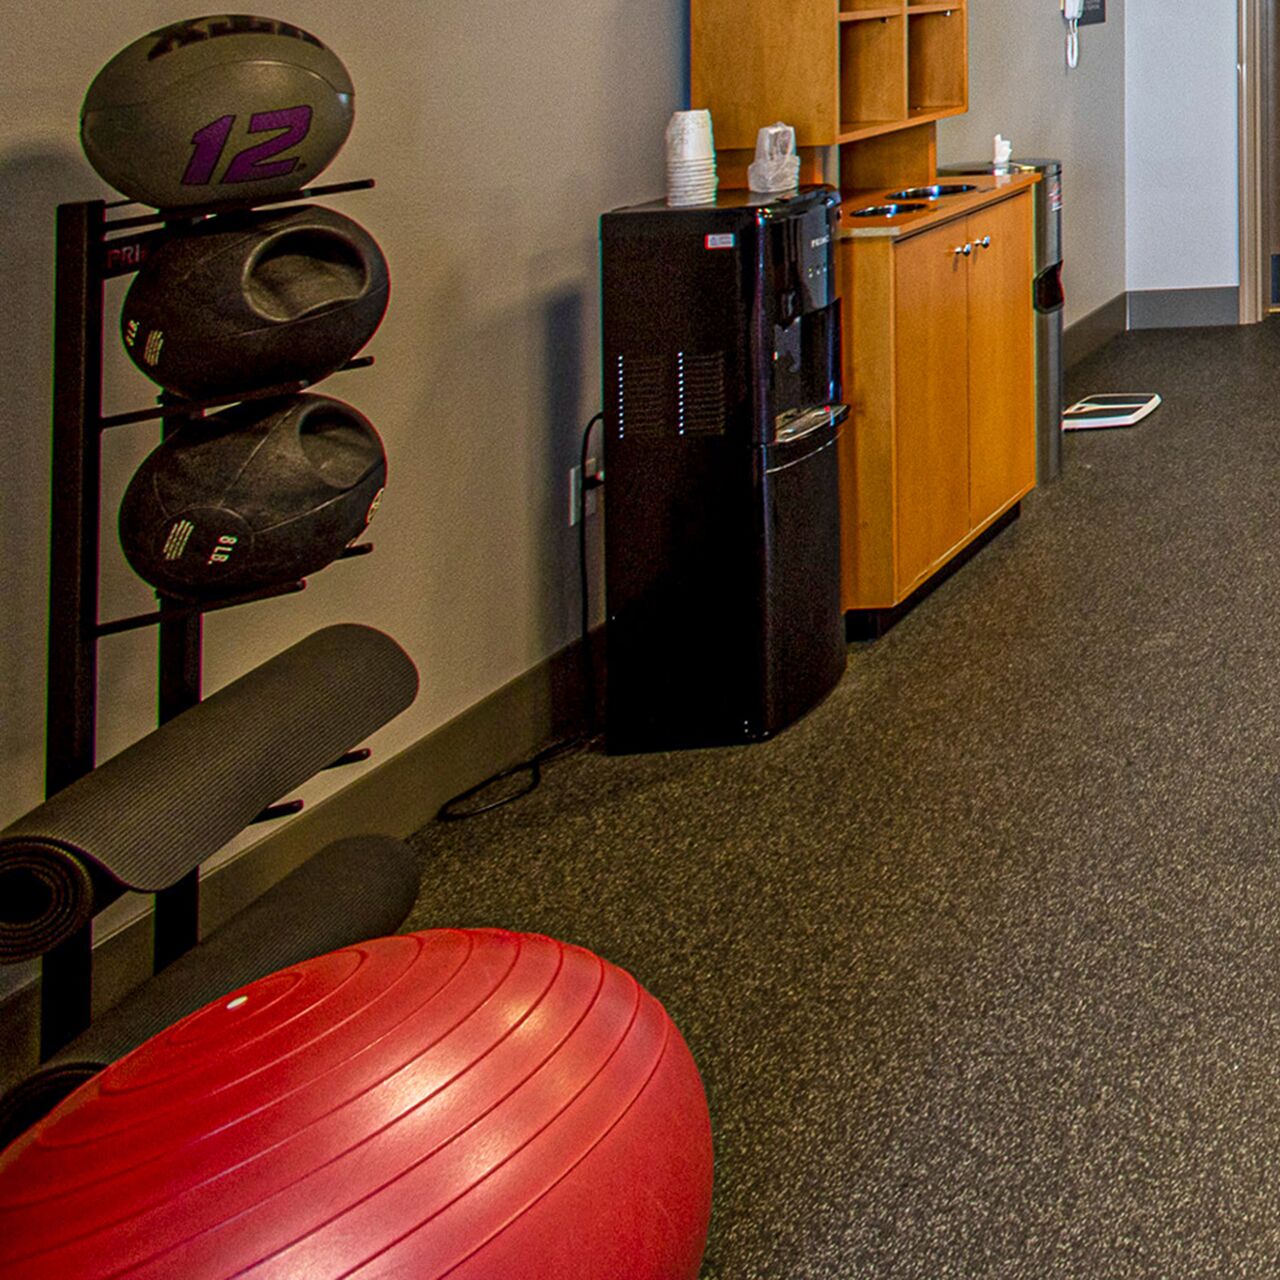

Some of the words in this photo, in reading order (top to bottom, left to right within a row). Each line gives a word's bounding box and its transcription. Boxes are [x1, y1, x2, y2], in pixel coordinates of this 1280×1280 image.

[180, 104, 313, 186] 12
[218, 534, 238, 546] 8
[207, 545, 233, 566] LB.
